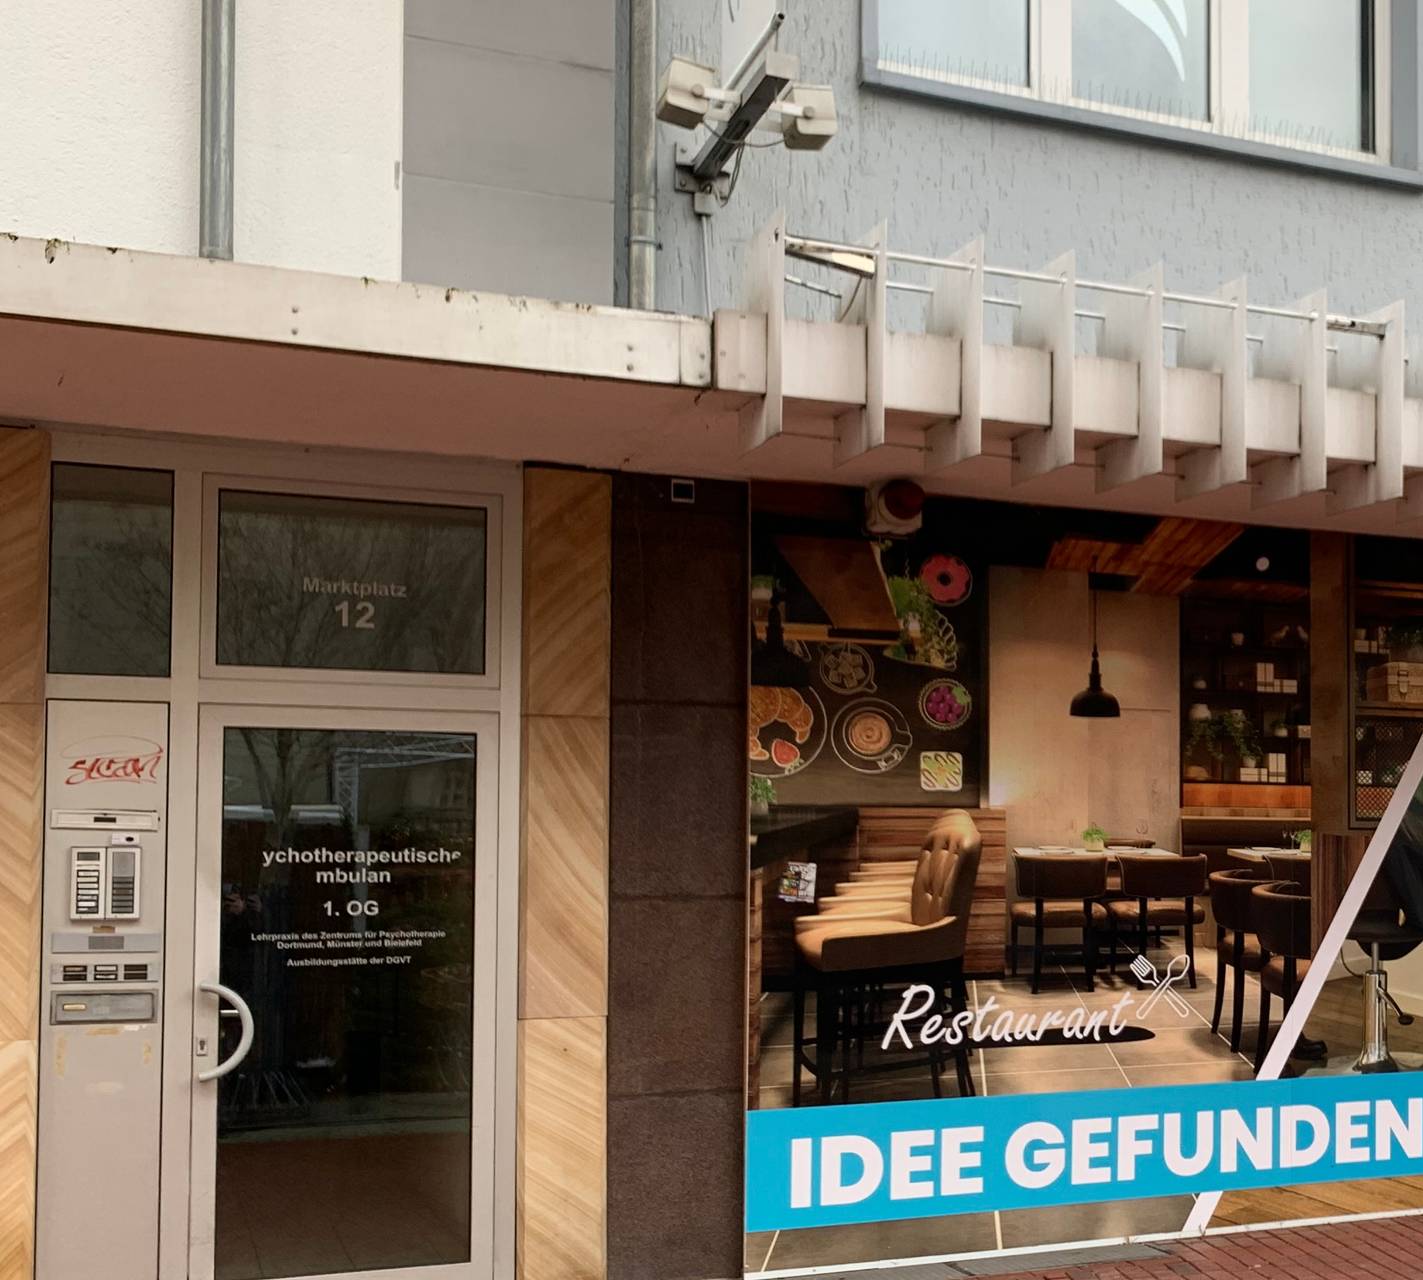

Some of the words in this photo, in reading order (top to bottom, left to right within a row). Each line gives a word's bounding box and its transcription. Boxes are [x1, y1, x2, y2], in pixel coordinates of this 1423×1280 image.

[303, 577, 408, 598] Marktplatz
[335, 600, 376, 629] 12
[315, 867, 391, 883] mbulan
[323, 900, 340, 917] 1.
[346, 900, 379, 916] OG
[251, 933, 300, 943] Lehrpraxis
[302, 932, 318, 940] des
[320, 931, 363, 940] Zentrums
[364, 930, 377, 939] für
[379, 930, 446, 941] Psychotherapie
[277, 940, 325, 949] Dortmund,
[327, 939, 362, 948] Münster
[365, 939, 382, 947] und
[384, 939, 422, 947] Bielefeld
[286, 957, 367, 968] Ausbildungsstätte
[369, 956, 385, 965] der
[386, 955, 412, 964] DGVT
[881, 983, 1135, 1052] Restaurant
[790, 1126, 985, 1209] IDEE
